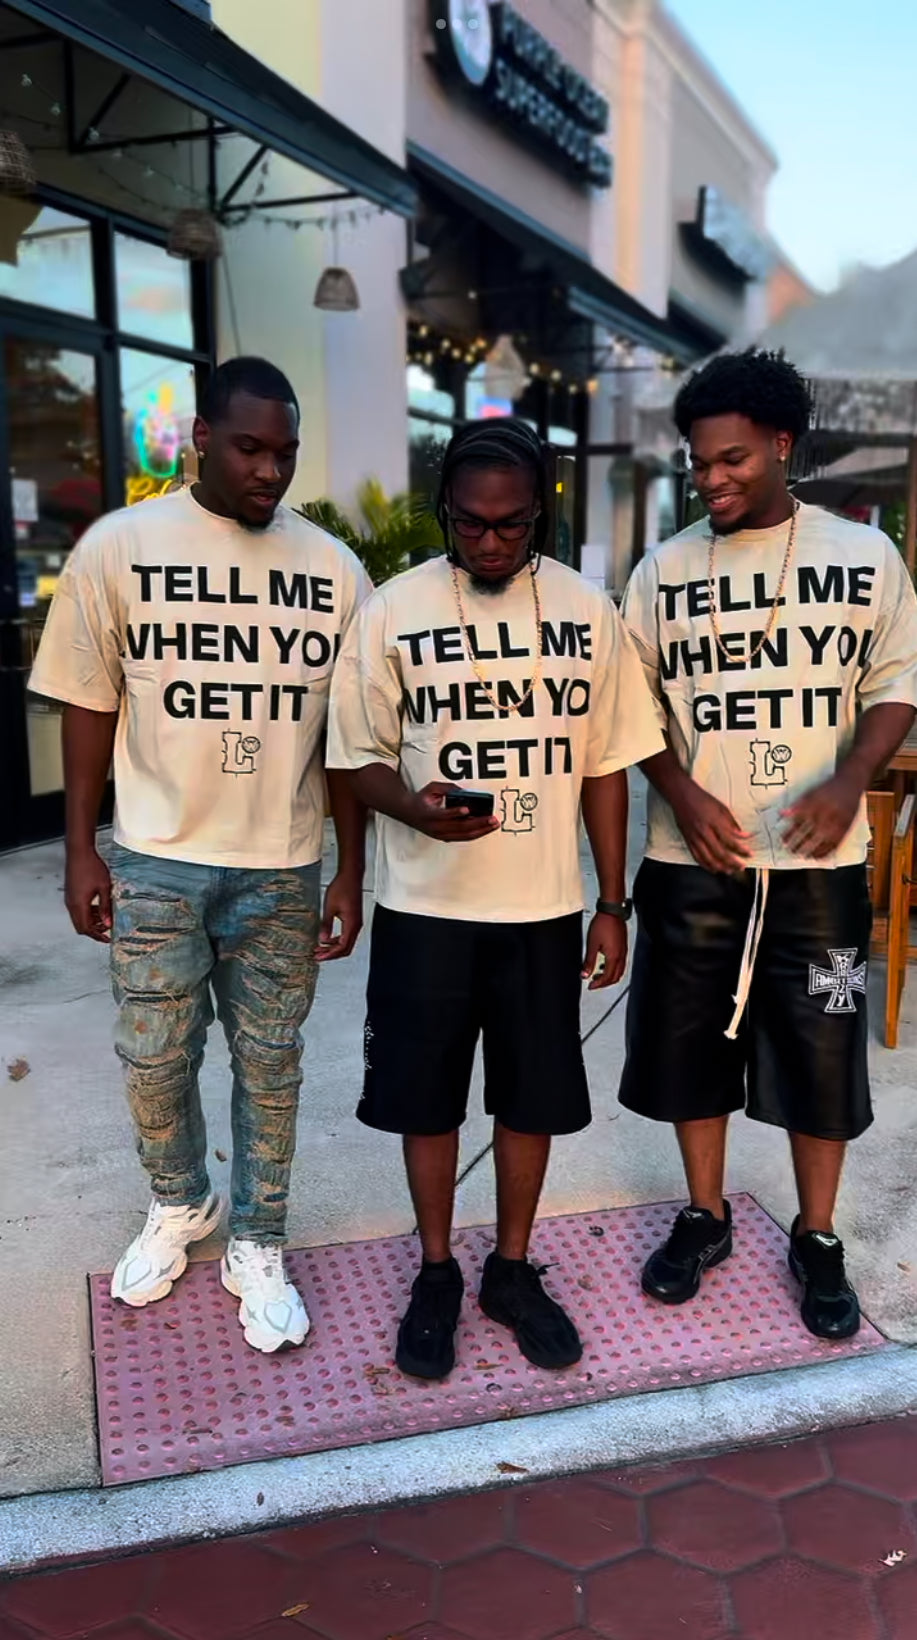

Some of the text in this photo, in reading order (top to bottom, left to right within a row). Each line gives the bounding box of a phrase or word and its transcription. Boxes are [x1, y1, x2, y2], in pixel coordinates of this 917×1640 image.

[131, 564, 334, 614] TELL ME
[658, 565, 876, 621] TELL ME
[397, 621, 592, 666] TELL ME
[163, 680, 309, 722] GET IT
[542, 678, 591, 717] YO
[692, 687, 843, 733] GET IT
[438, 738, 539, 781] GET
